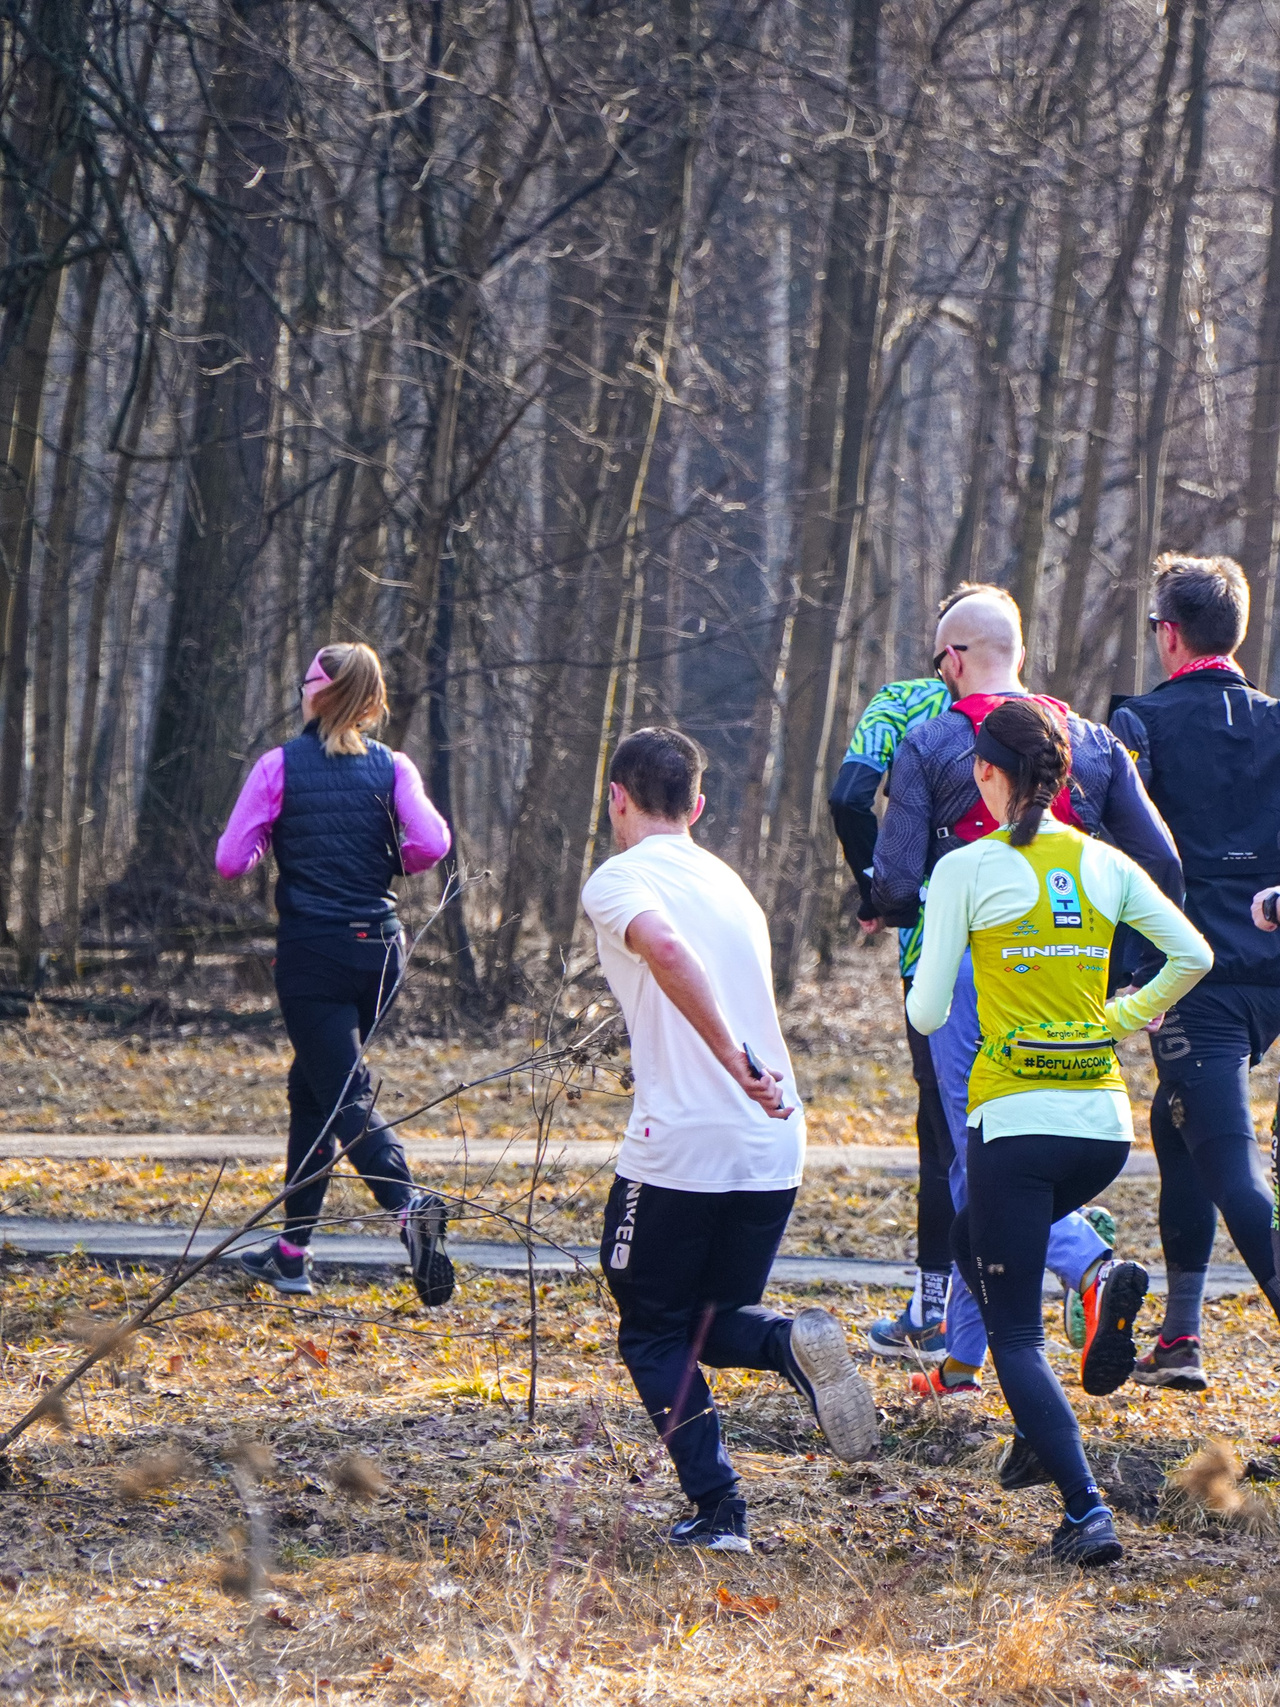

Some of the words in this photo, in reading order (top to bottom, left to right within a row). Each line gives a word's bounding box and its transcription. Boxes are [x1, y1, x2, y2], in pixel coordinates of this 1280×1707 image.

[1056, 899, 1074, 911] T
[1055, 915, 1081, 925] 30
[615, 1182, 643, 1242] NIKE
